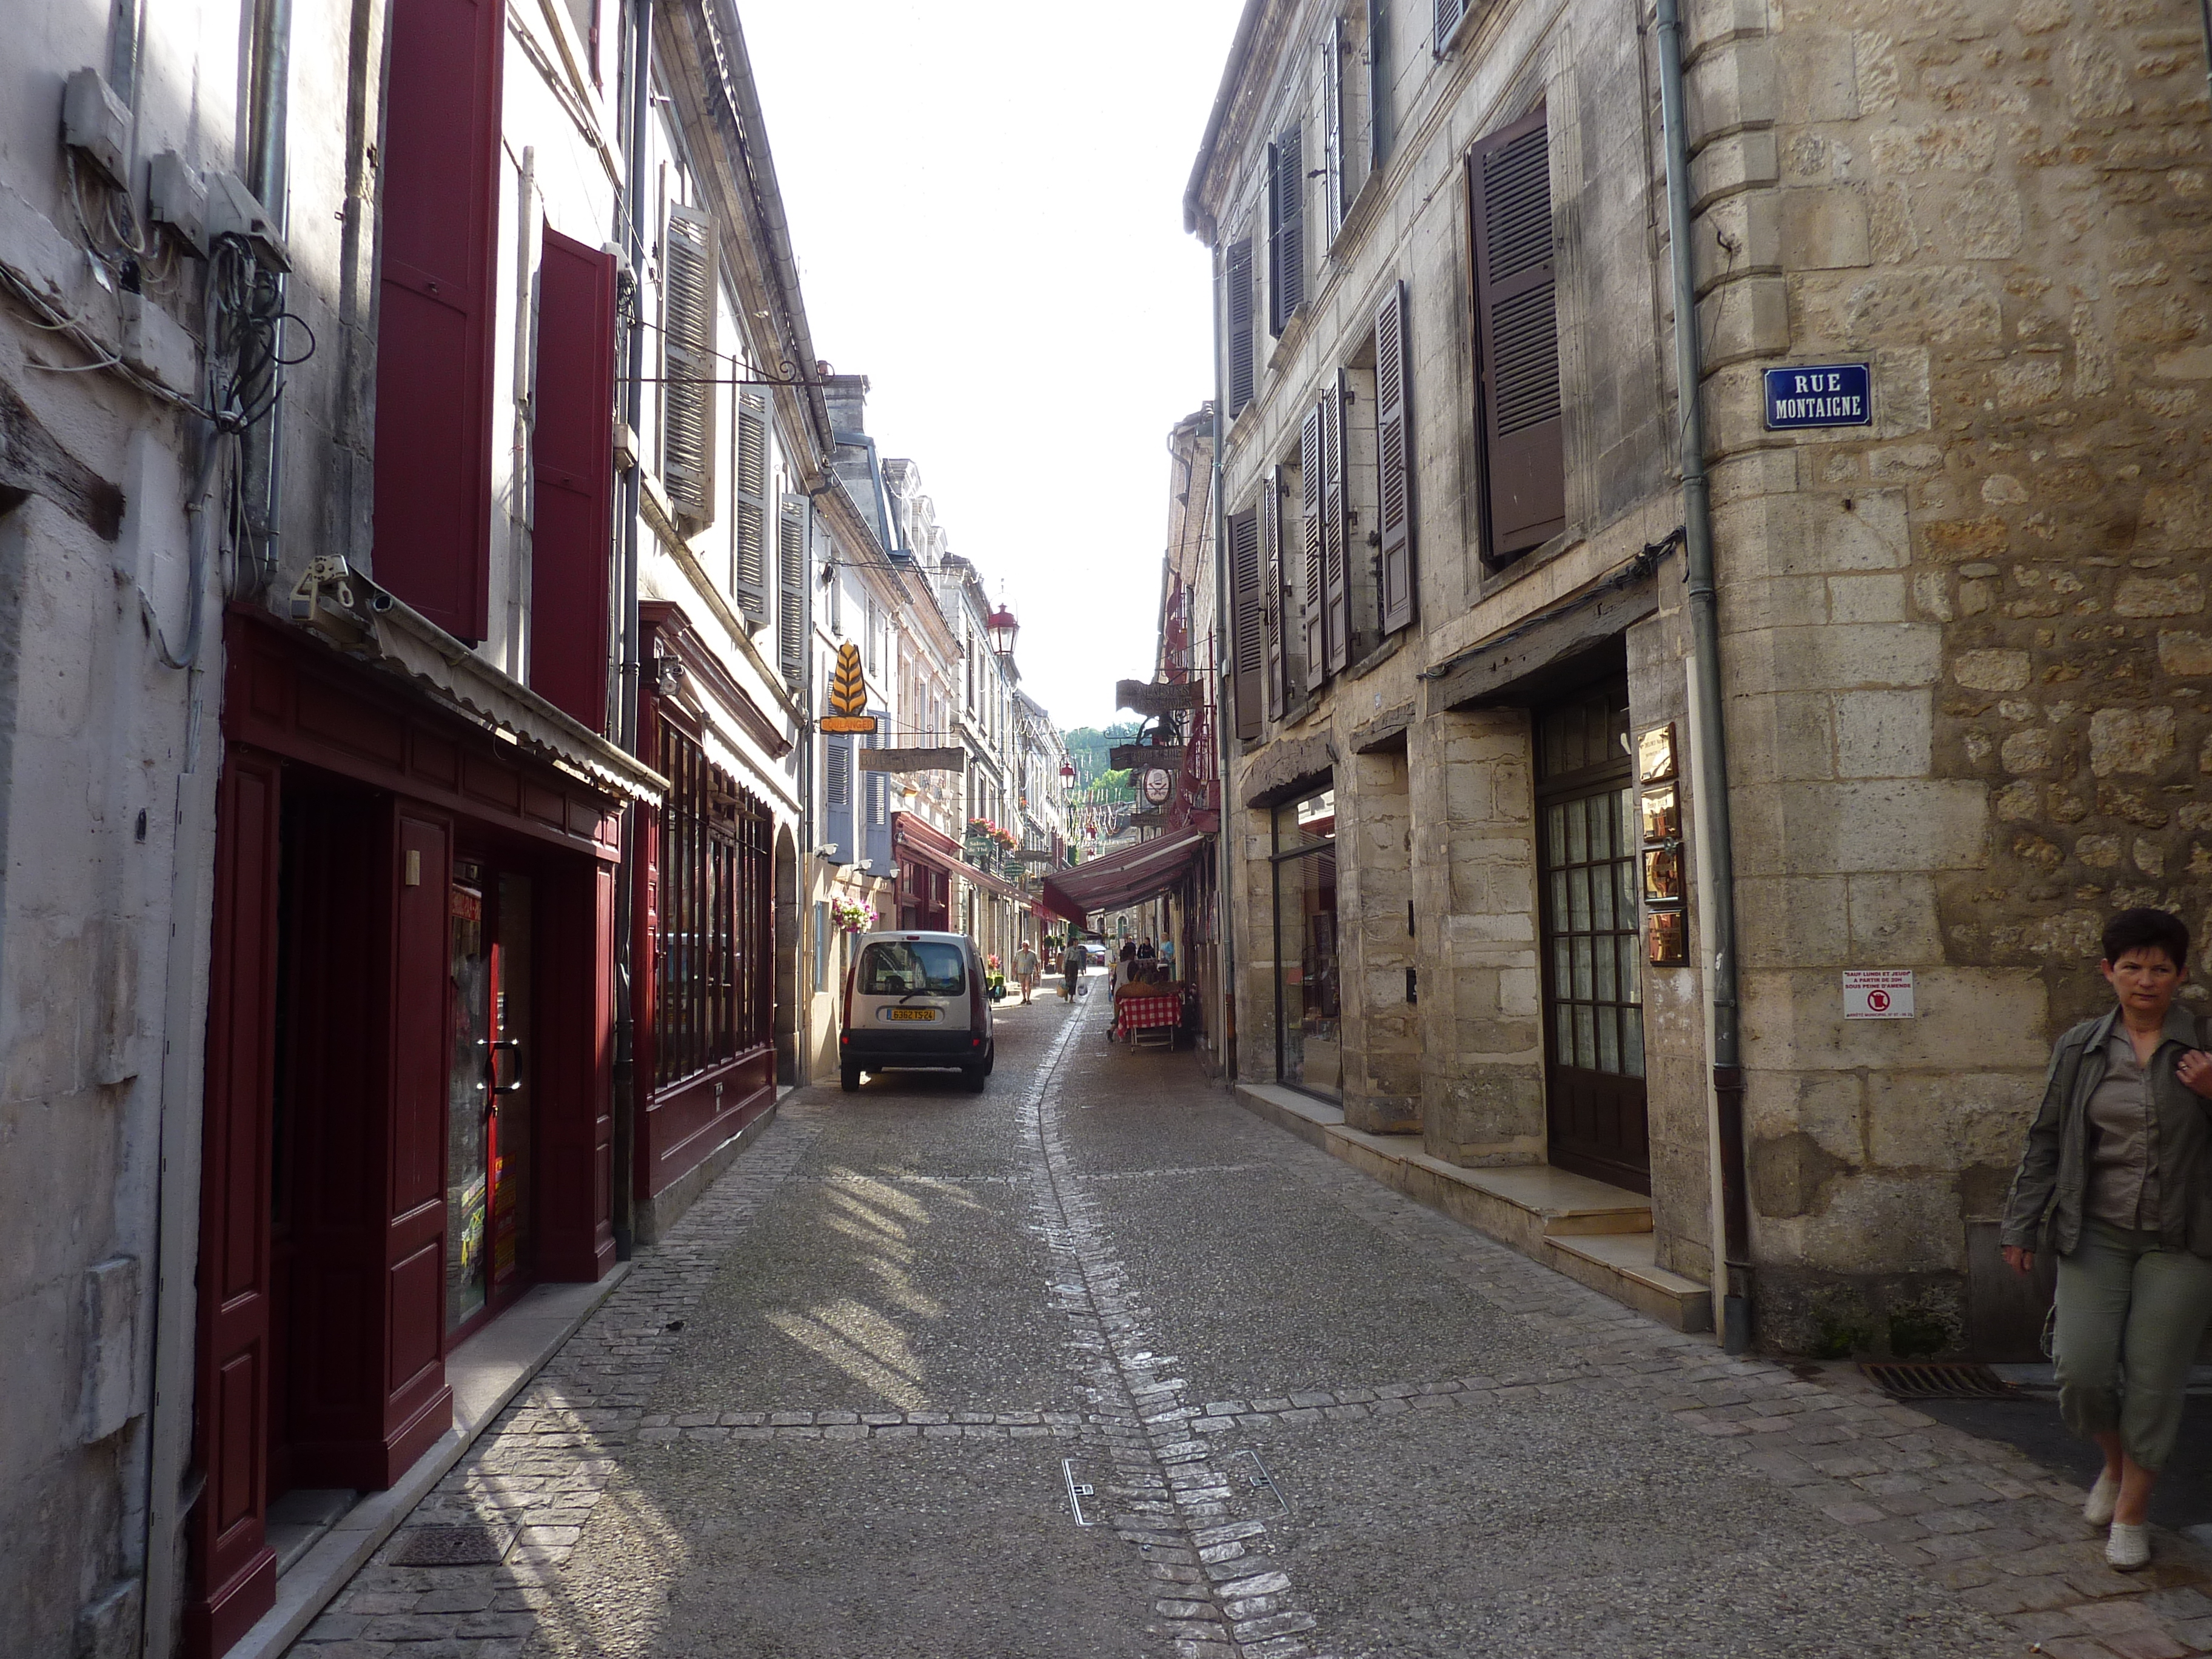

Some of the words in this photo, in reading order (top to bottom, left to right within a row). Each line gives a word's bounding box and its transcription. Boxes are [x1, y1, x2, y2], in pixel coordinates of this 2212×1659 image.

[1794, 374, 1841, 393] RUE
[1776, 396, 1861, 419] MONTAIGNE
[822, 720, 873, 729] BOULANGER
